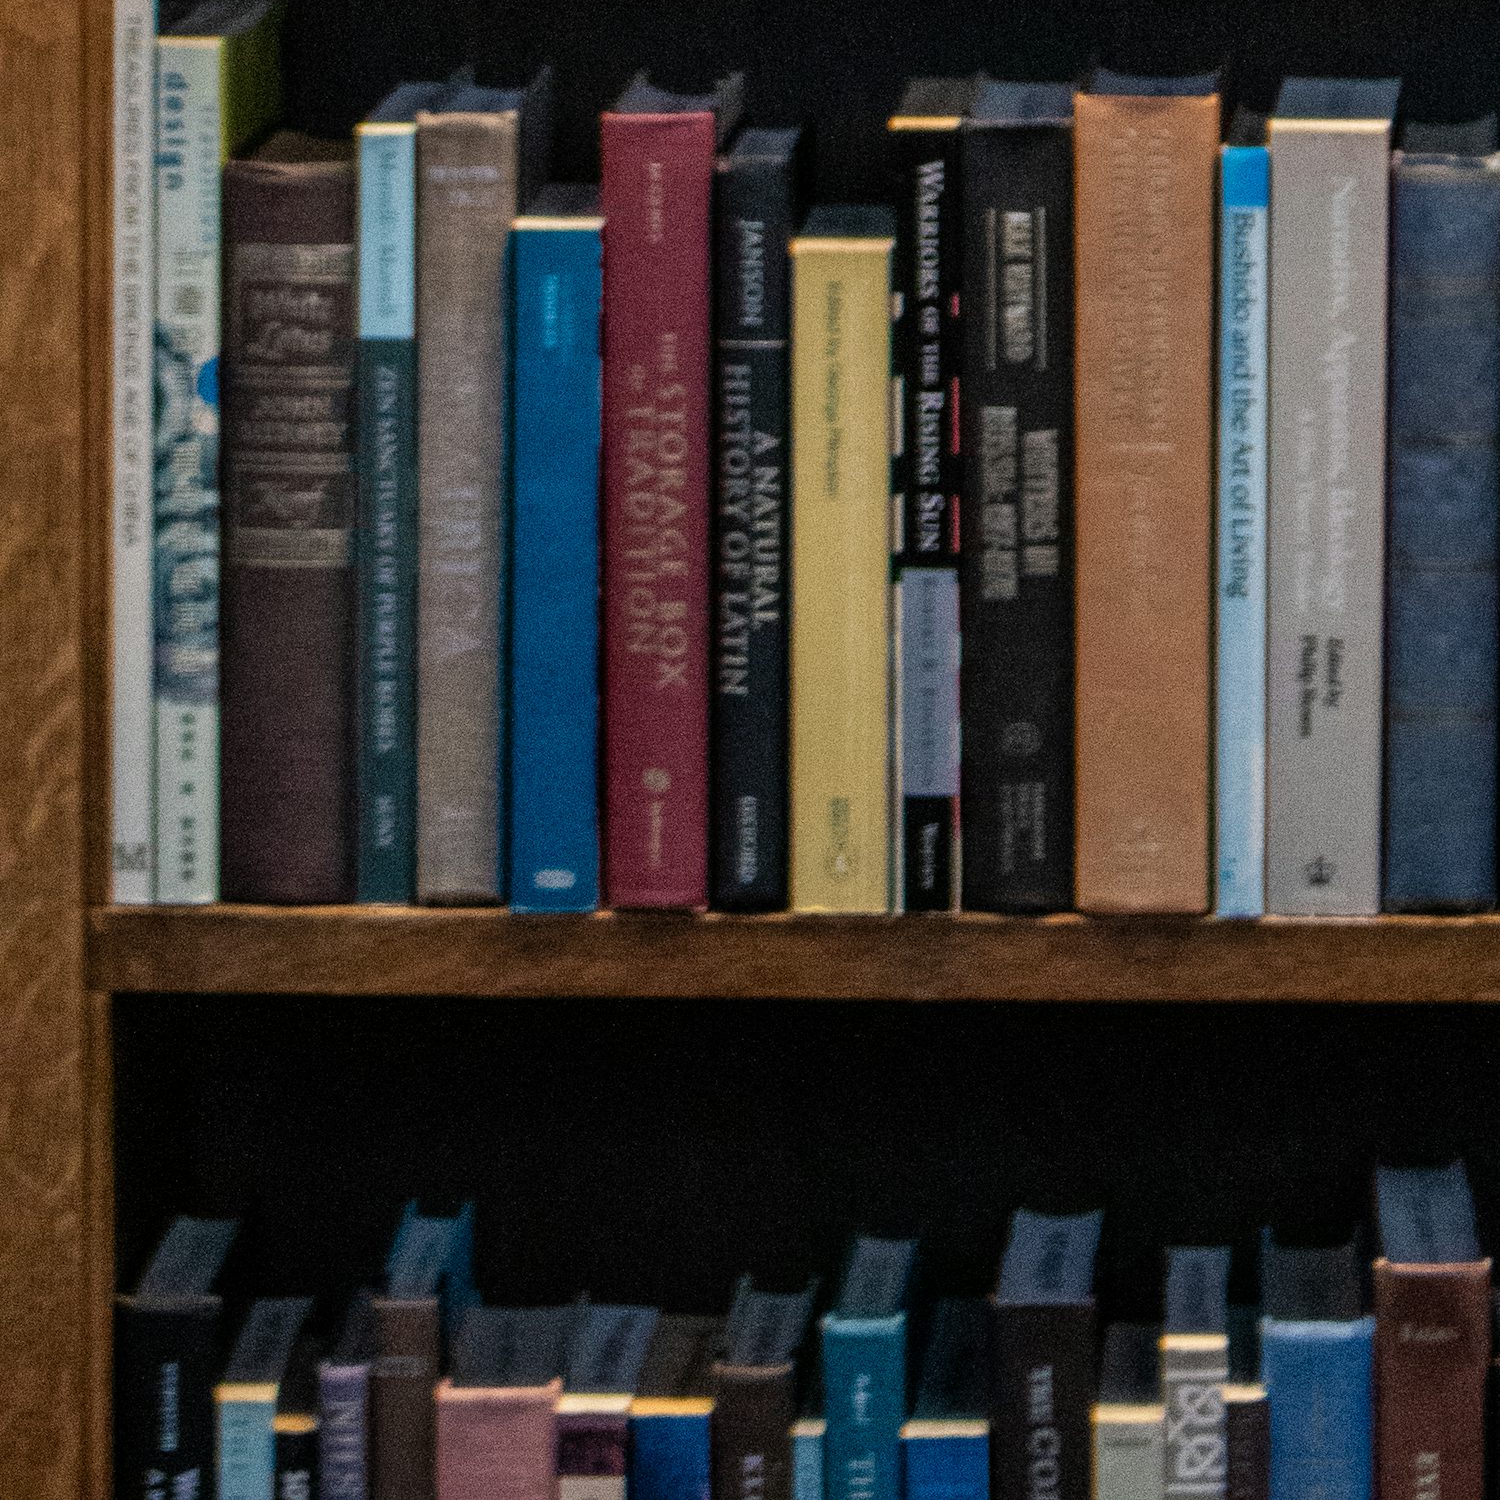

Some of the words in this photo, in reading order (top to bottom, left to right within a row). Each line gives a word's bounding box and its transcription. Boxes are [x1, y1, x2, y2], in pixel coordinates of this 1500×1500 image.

[738, 219, 768, 326] JANSON
[919, 160, 945, 299] WARRIORS
[1229, 211, 1259, 331] Bushido
[1229, 339, 1259, 379] and
[721, 363, 751, 518] HISTORY
[754, 430, 781, 454] A
[919, 391, 945, 487] RISING
[1229, 387, 1259, 431] the
[658, 382, 689, 578] STORAGE
[1229, 441, 1259, 477] Art
[1229, 484, 1259, 512] of
[626, 405, 656, 654] TRADITION
[721, 531, 751, 582] OF
[752, 466, 781, 631] NATURAL
[919, 494, 945, 551] SUN
[1225, 519, 1259, 598] Living
[656, 602, 688, 689] BOX
[721, 592, 751, 697] LATIN
